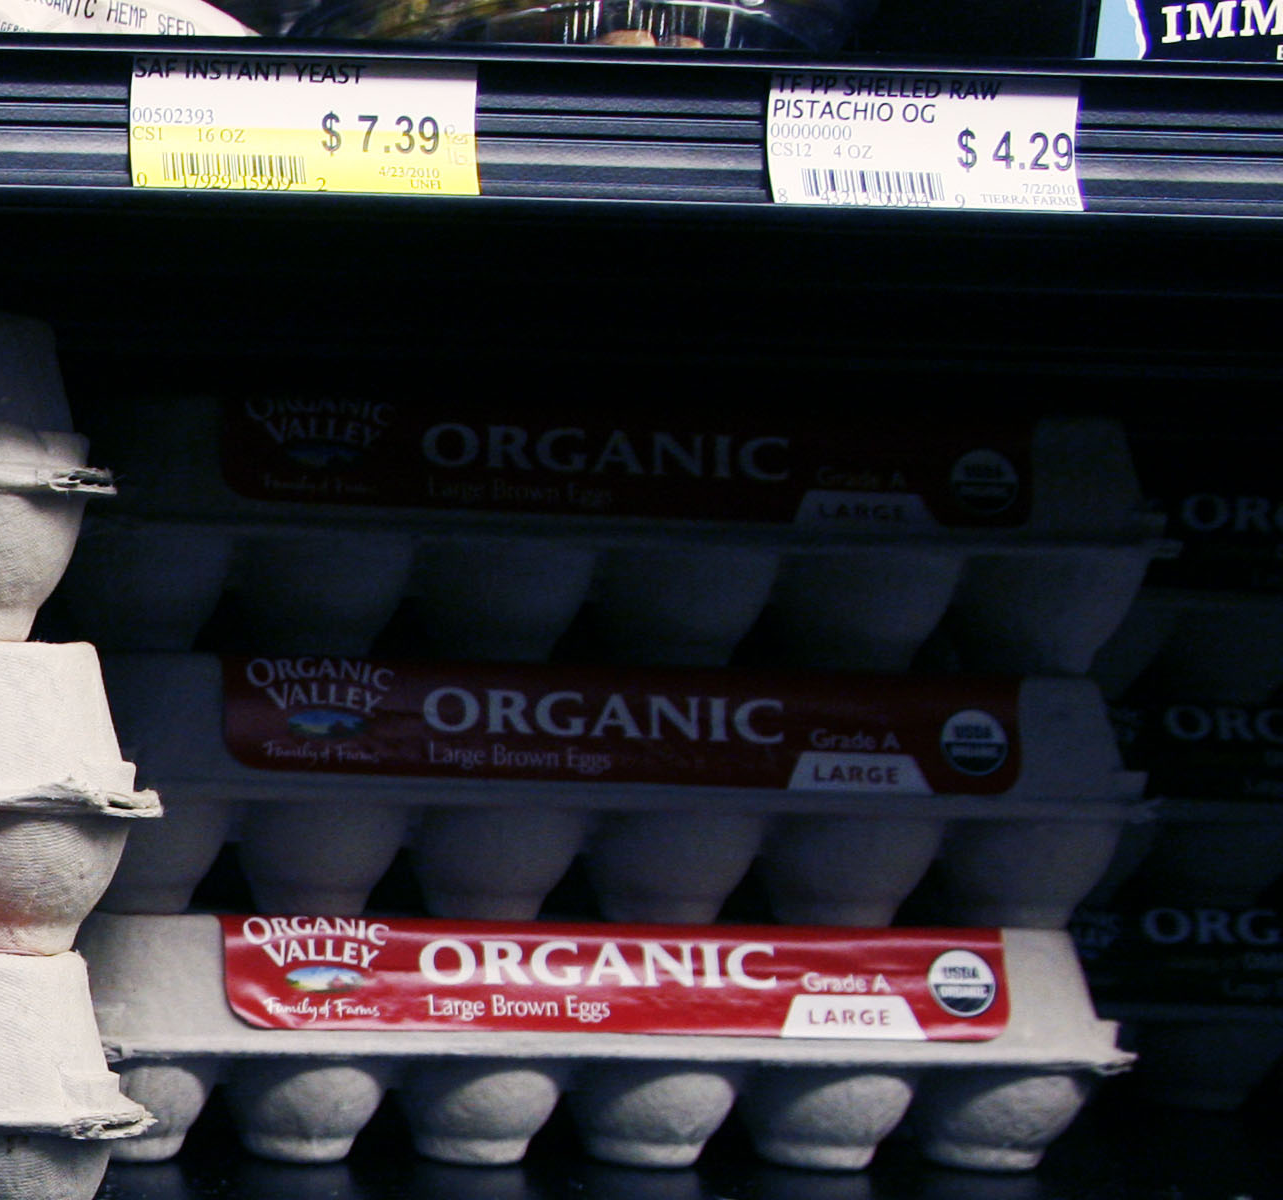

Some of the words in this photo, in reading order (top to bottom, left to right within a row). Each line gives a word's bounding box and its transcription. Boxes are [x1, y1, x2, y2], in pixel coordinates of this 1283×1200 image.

[106, 0, 148, 29] HEMP
[133, 57, 178, 79] SAF
[185, 58, 287, 82] INSTANT
[293, 62, 367, 84] YEAST
[774, 73, 805, 94] TF
[842, 76, 942, 99] SHELLED
[948, 78, 1002, 101] RAW
[132, 106, 215, 125] 00502393
[773, 98, 895, 122] PISTACHIO
[901, 102, 937, 124] OG
[196, 127, 215, 143] 16
[219, 128, 247, 144] OZ
[321, 111, 342, 156] $
[356, 114, 441, 154] 7.39
[847, 144, 874, 160] OZ
[956, 127, 978, 173] $
[991, 130, 1075, 172] 4.29
[418, 939, 778, 990] ORGANIC
[807, 1007, 894, 1027] LARGE
